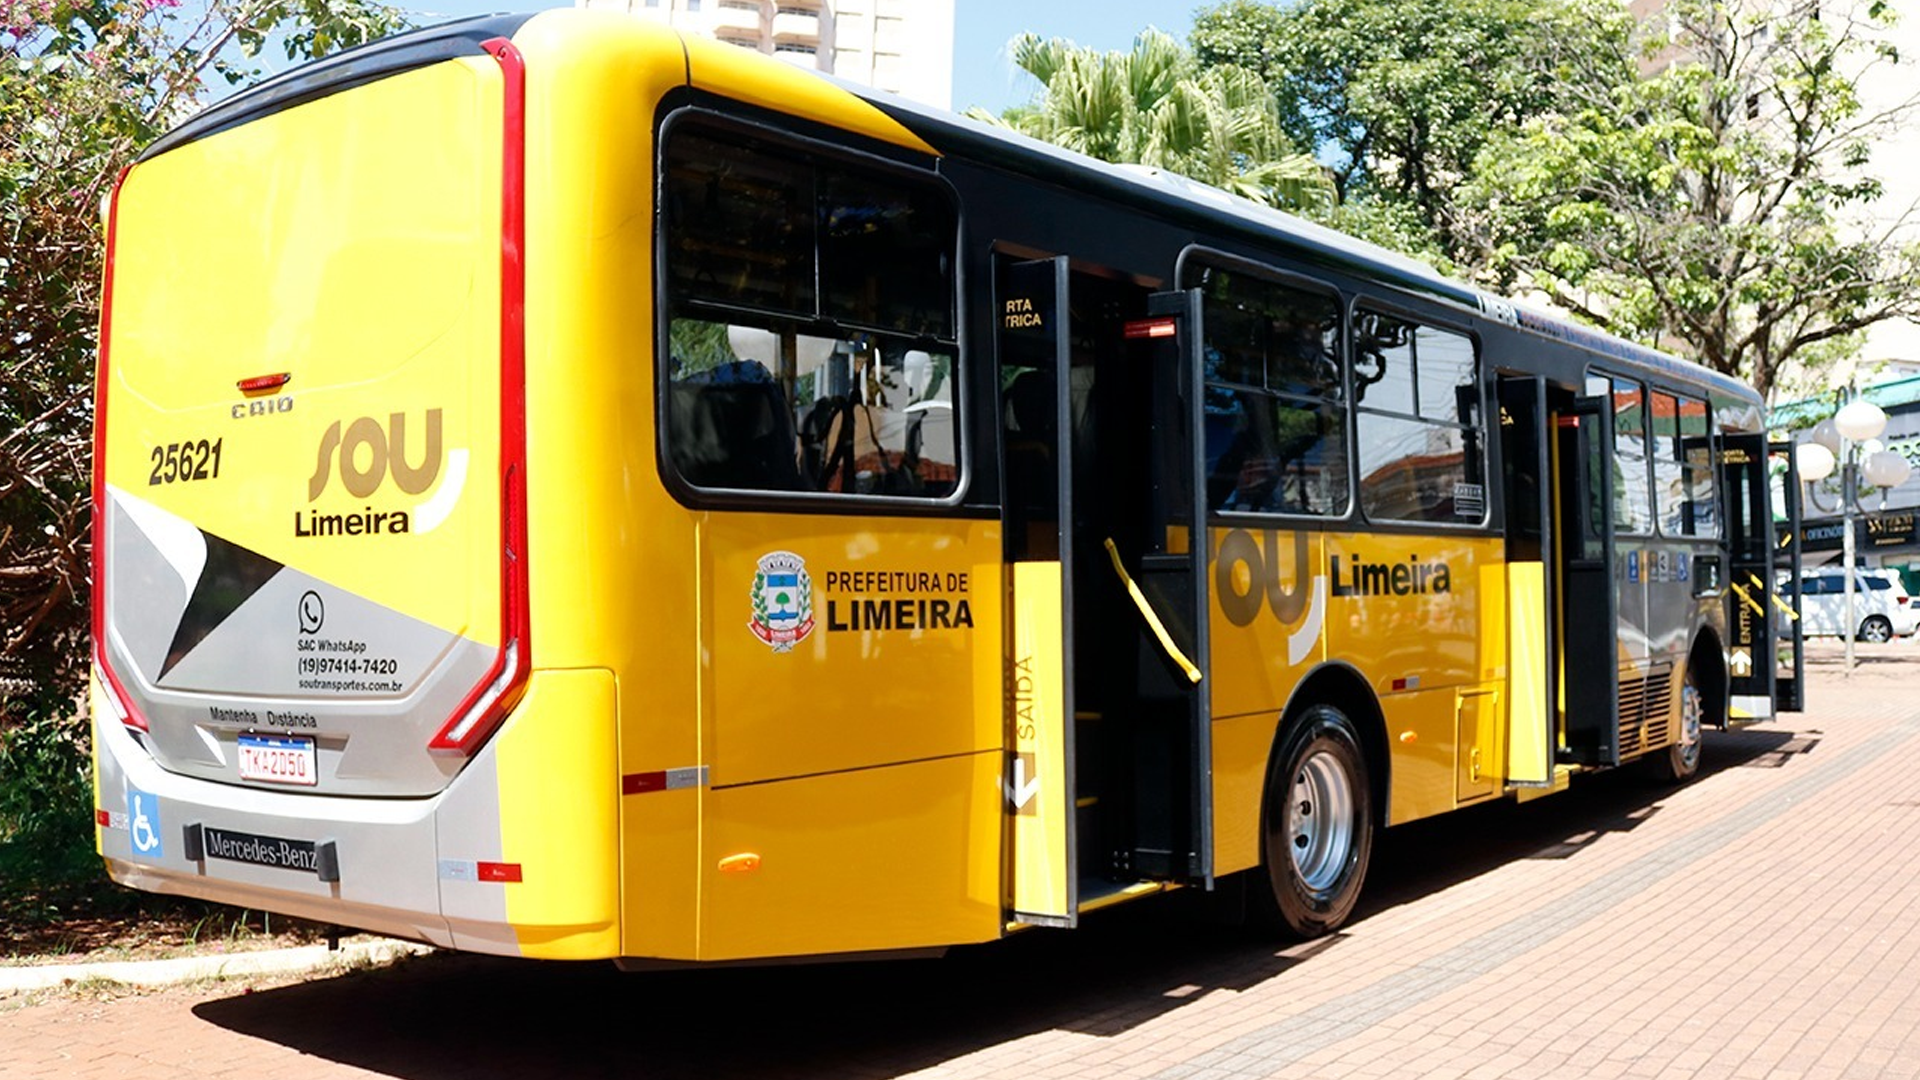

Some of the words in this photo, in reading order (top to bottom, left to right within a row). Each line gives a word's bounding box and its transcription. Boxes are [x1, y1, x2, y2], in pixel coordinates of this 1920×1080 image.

[231, 397, 293, 419] CAIO
[149, 438, 222, 486] 25621
[308, 408, 443, 503] SOU
[295, 507, 410, 538] Limeira
[826, 571, 942, 593] PREFEITURA
[946, 573, 969, 593] DE
[1207, 526, 1310, 628] OU
[1330, 554, 1451, 597] Limeira
[827, 598, 974, 632] LIMEIRA
[297, 639, 316, 652] SAC
[317, 640, 367, 655] WhatsApp
[298, 658, 398, 675] (19)97414-7420
[299, 679, 403, 692] soutransportes.com.br
[209, 706, 258, 724] Mantenha
[266, 710, 318, 728] Distância
[208, 831, 318, 869] Mercedes-Benz
